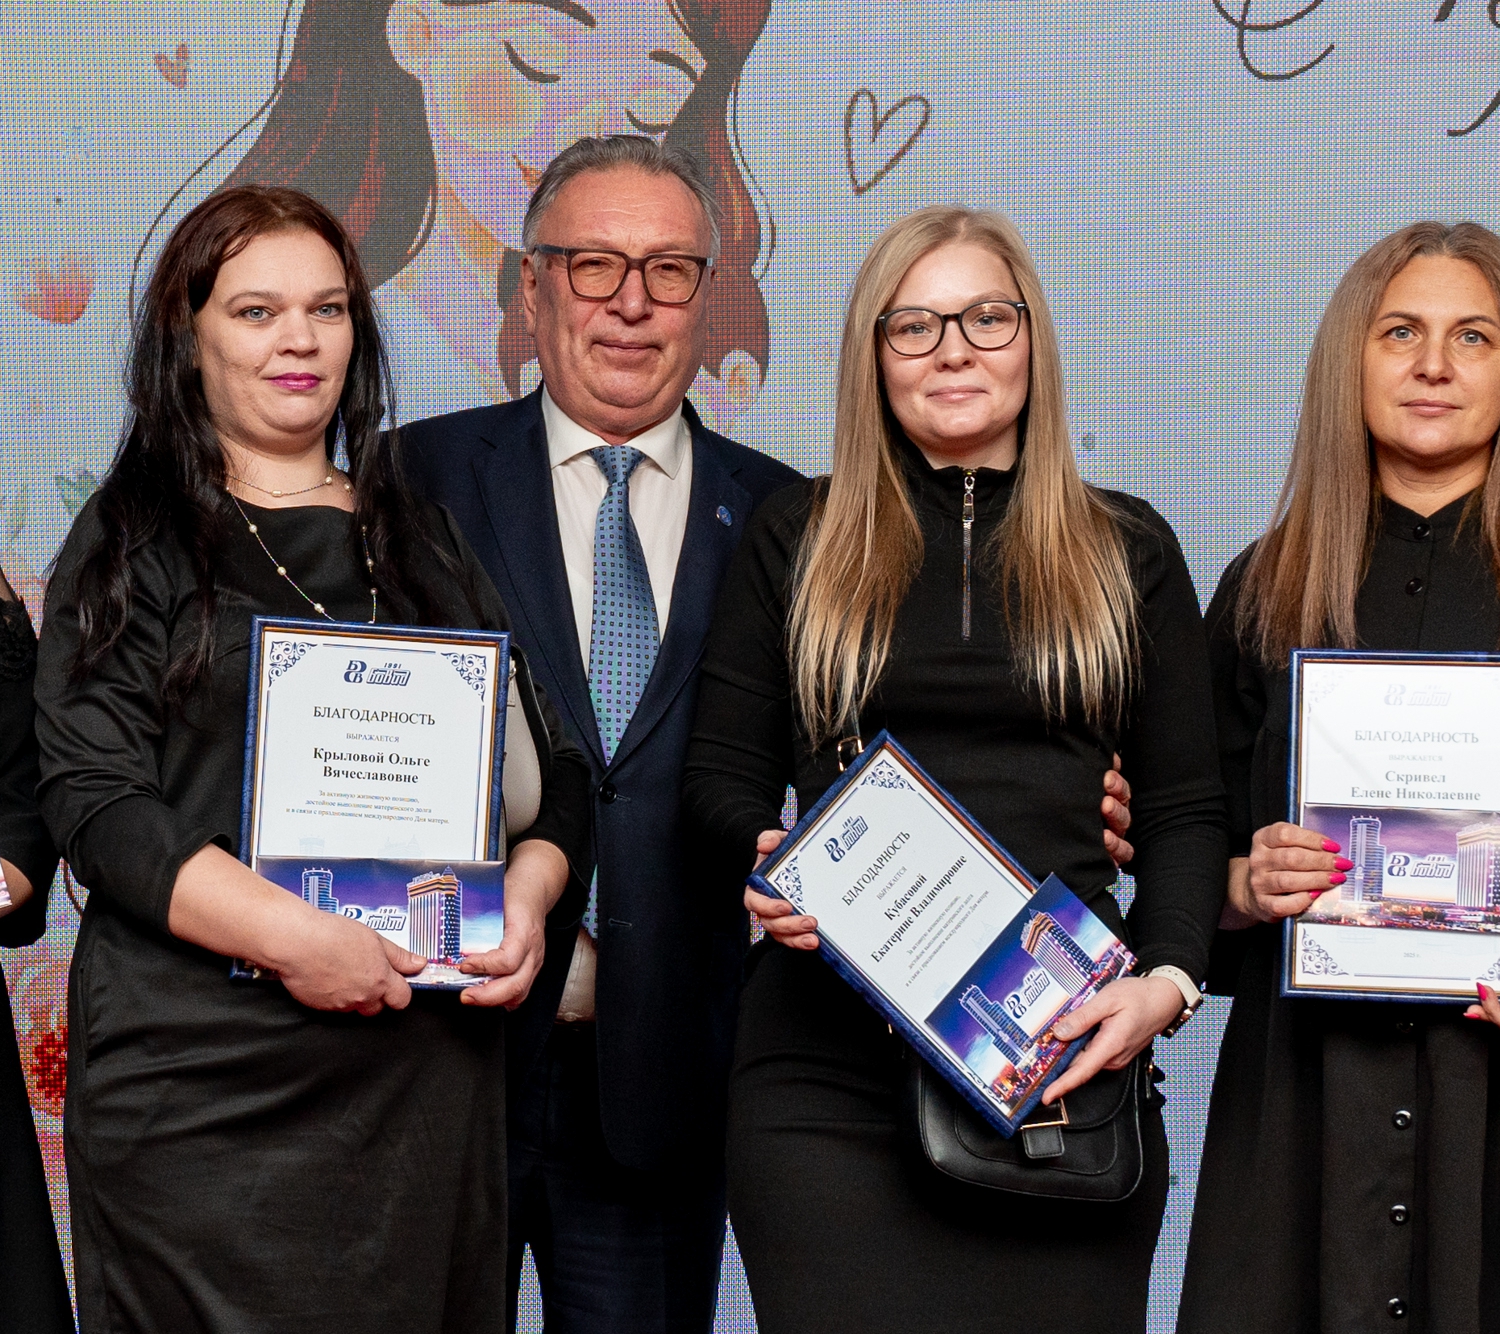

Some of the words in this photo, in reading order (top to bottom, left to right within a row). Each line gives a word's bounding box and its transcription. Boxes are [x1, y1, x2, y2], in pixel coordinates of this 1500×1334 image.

[313, 705, 436, 726] БЛАГОДАРНОСТЬ
[1354, 730, 1480, 744] БЛАГОДАРНОСТЬ
[313, 747, 384, 764] Крыловой
[388, 752, 431, 767] Ольге
[323, 765, 419, 784] Вячеславовне
[841, 831, 911, 907] БЛАГОДАРНОСТЬ
[883, 873, 928, 921] Кубасовой
[870, 916, 914, 963] Екатерине
[909, 855, 967, 918] Владимировне
